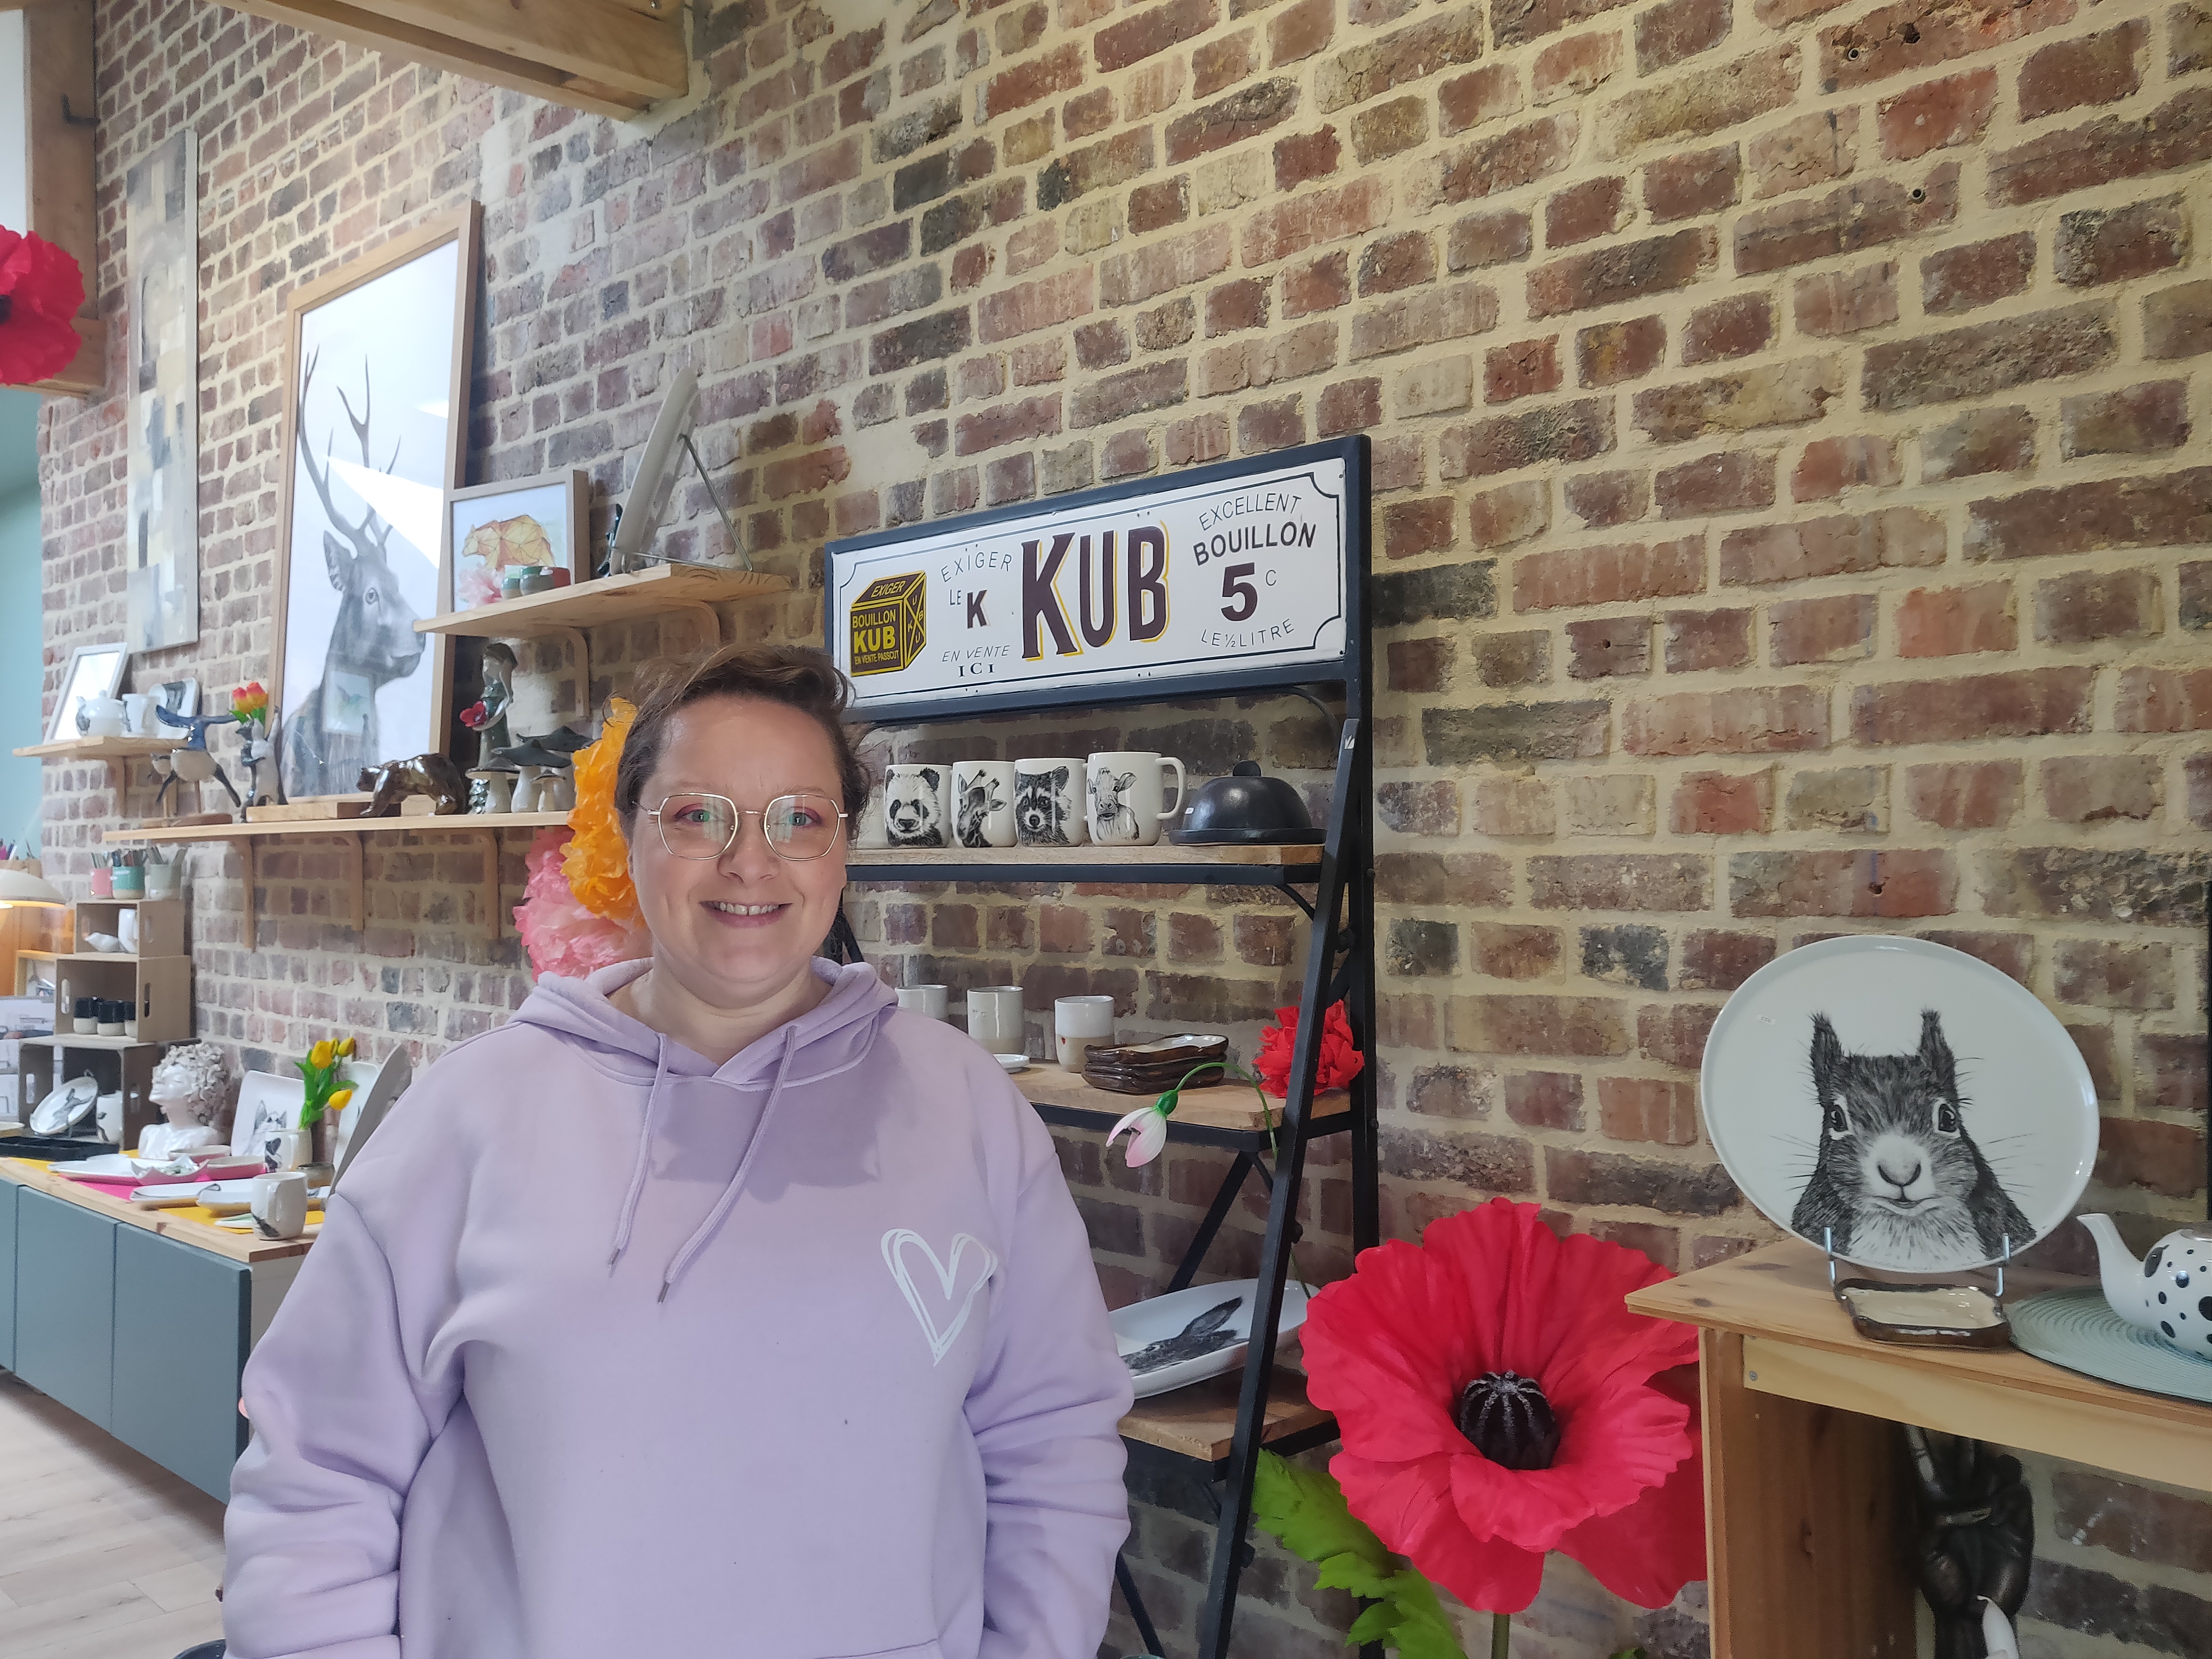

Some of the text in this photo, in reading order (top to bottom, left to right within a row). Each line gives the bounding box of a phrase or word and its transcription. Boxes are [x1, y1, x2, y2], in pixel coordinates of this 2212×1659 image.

[1199, 493, 1301, 531] EXCELLENT
[1193, 521, 1316, 566] BOUILLON
[941, 552, 1012, 582] EXIGER
[871, 580, 906, 598] EXIGER
[1021, 525, 1168, 660] KUB
[1221, 562, 1258, 621] 5
[853, 609, 896, 628] BOUILLON
[950, 589, 987, 629] LE K
[854, 625, 896, 654] KUB
[1201, 629, 1222, 646] LE
[1239, 618, 1295, 647] LITRE
[854, 655, 862, 665] EN
[861, 653, 878, 663] VENTE
[942, 645, 1010, 662] EN VENTE
[958, 662, 995, 677] ICI
